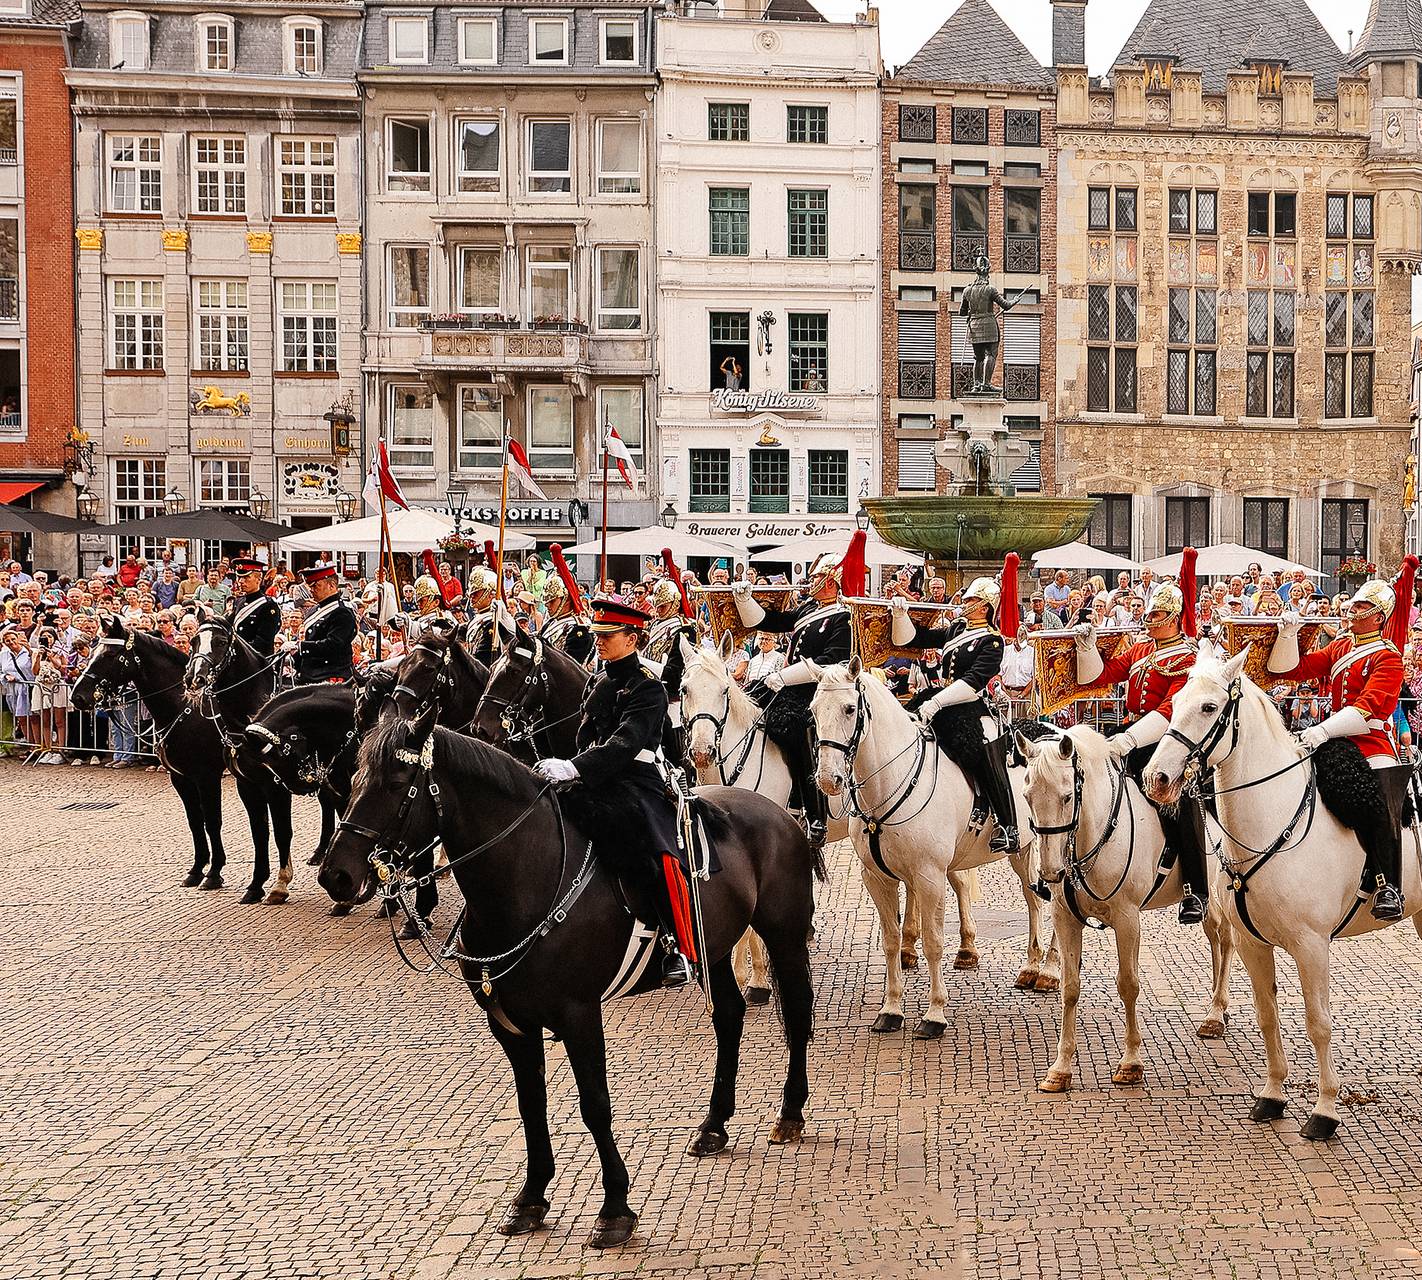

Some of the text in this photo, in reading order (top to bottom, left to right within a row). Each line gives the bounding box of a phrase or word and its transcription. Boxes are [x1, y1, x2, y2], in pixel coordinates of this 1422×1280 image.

[123, 434, 149, 446] Zum
[196, 436, 244, 448] goldenen
[284, 436, 329, 449] Einhorn
[686, 523, 850, 538] Brauerei Goldener Sch
